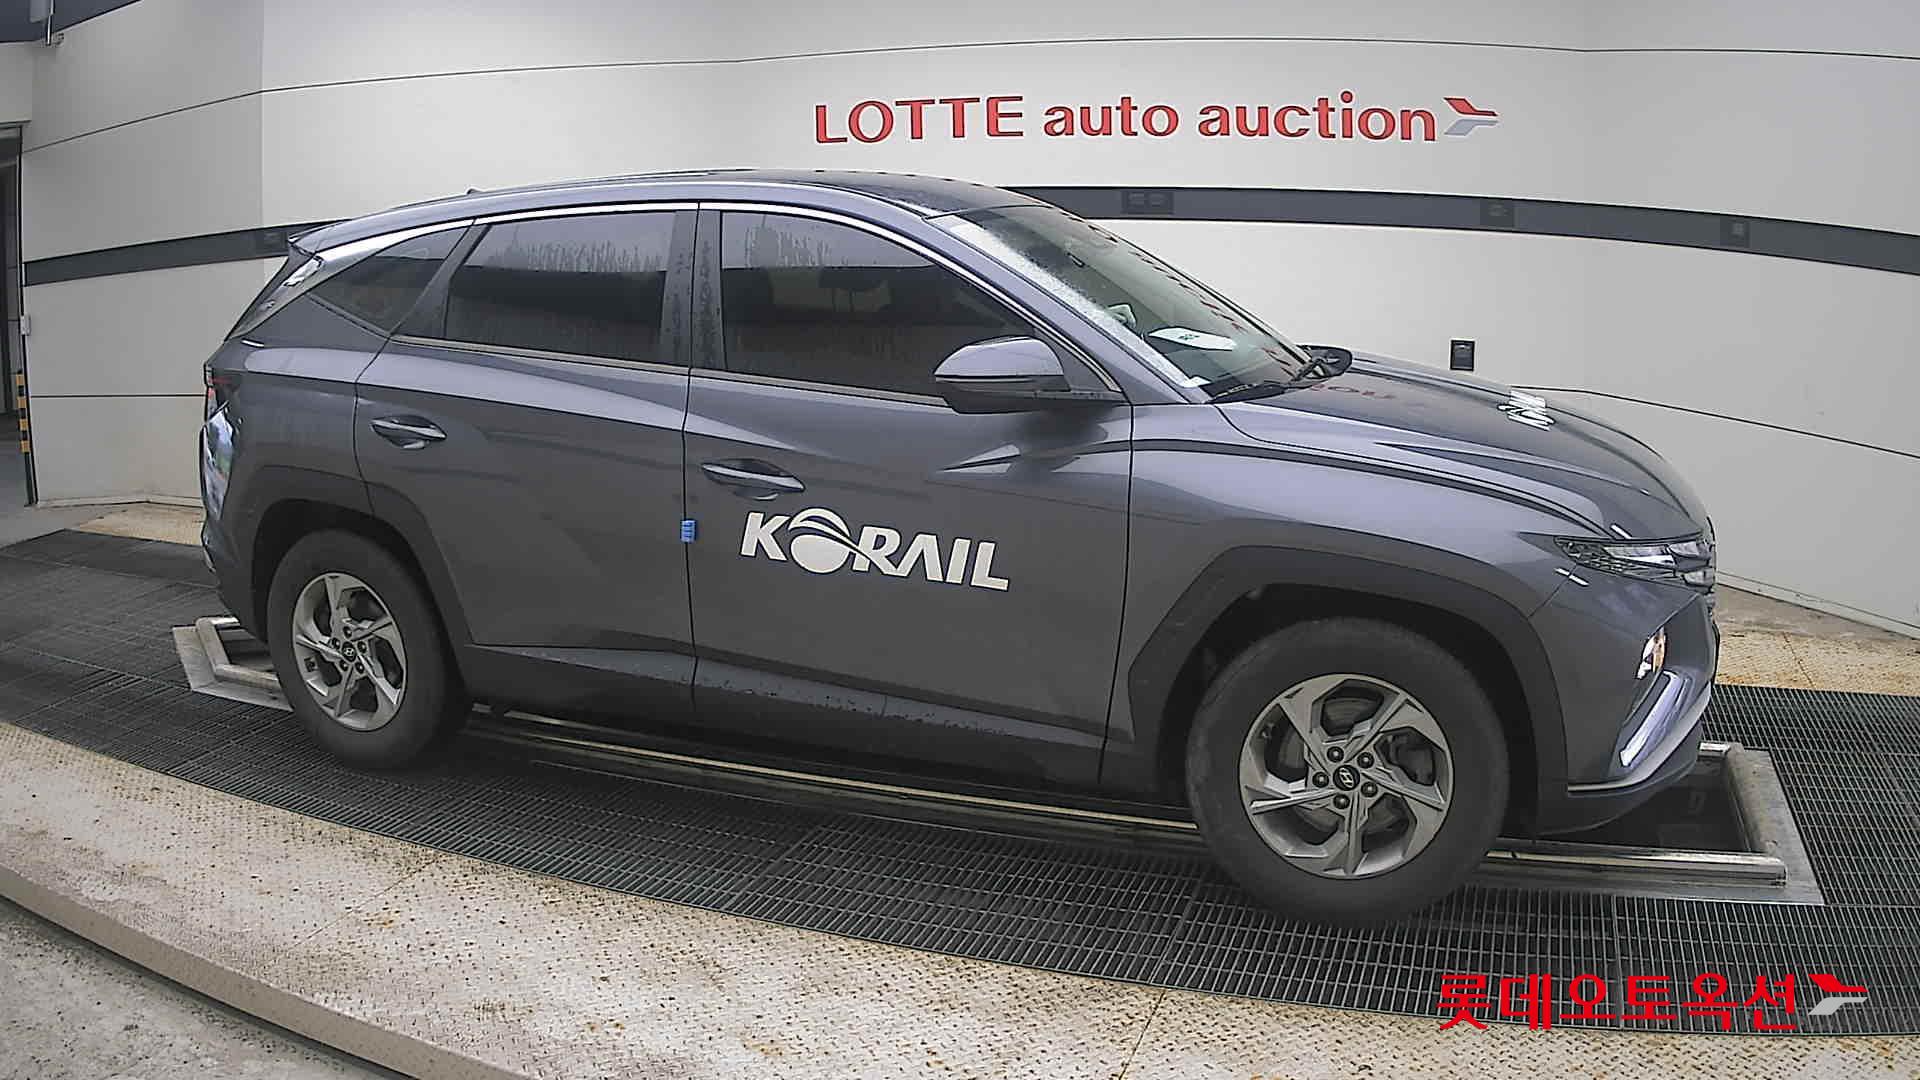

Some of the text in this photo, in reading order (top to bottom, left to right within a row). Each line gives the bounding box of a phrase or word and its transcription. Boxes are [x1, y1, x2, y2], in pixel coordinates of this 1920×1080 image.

[814, 91, 1438, 144] LOTTE auto auction
[740, 507, 1009, 591] KORAIL
